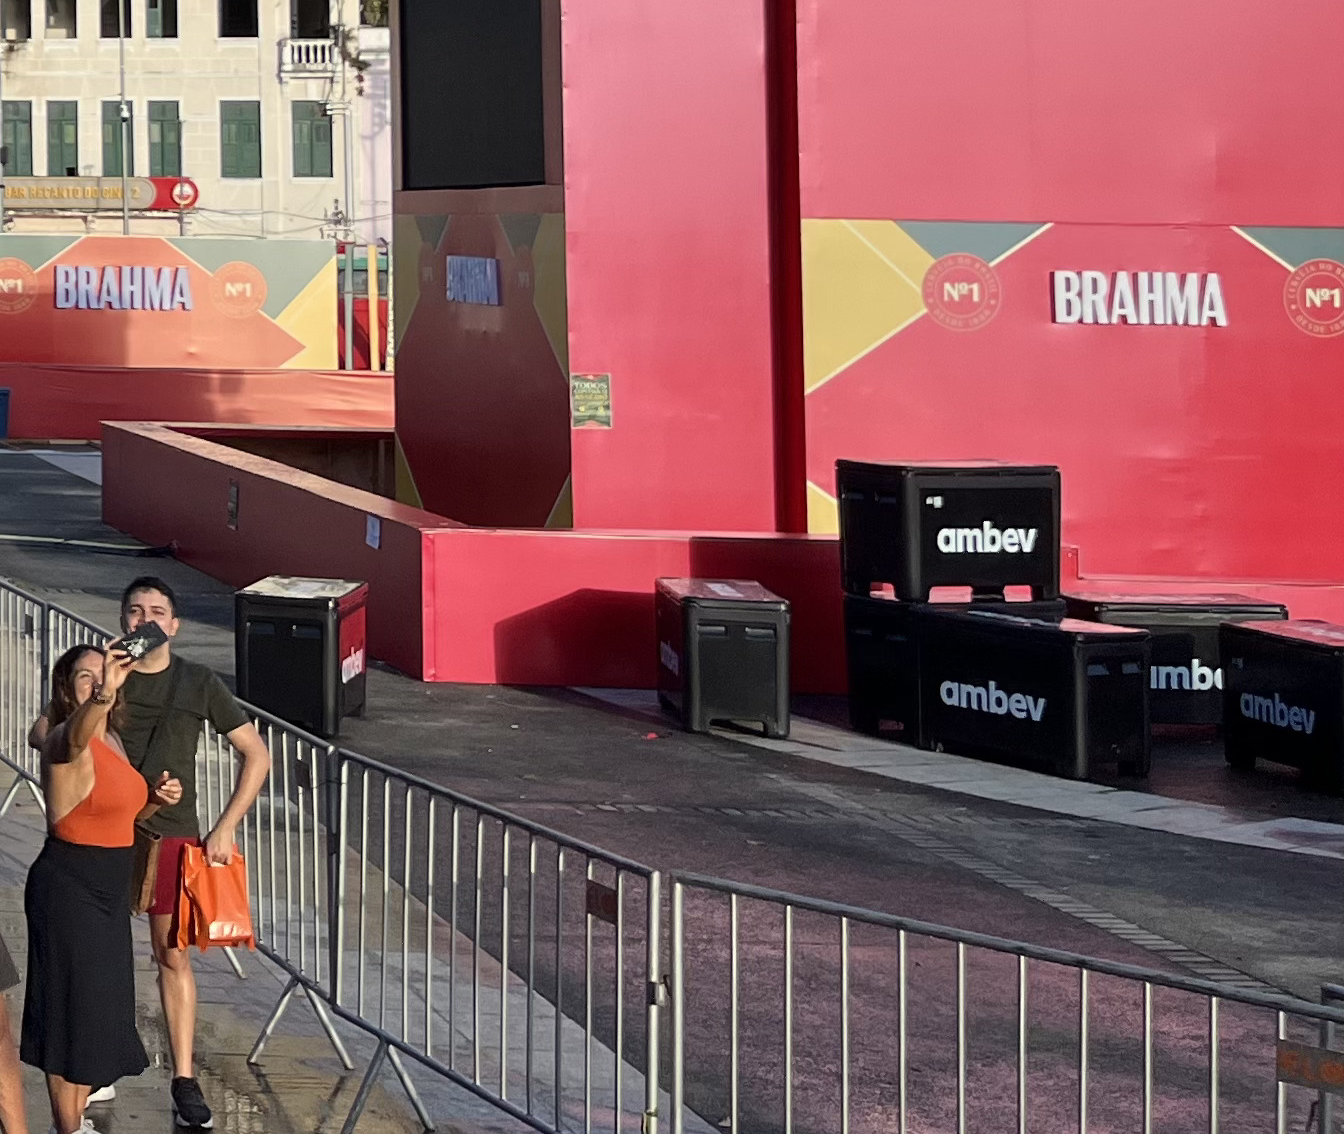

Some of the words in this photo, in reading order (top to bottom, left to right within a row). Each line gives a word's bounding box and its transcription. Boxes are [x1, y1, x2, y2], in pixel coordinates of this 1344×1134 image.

[54, 265, 193, 311] BRAHMA
[943, 282, 979, 302] Nº1
[1052, 270, 1229, 327] BRAHMA
[1305, 288, 1341, 308] Nº1
[936, 521, 1039, 554] ambev
[939, 679, 1047, 722] ambev
[1240, 692, 1317, 734] ambev
